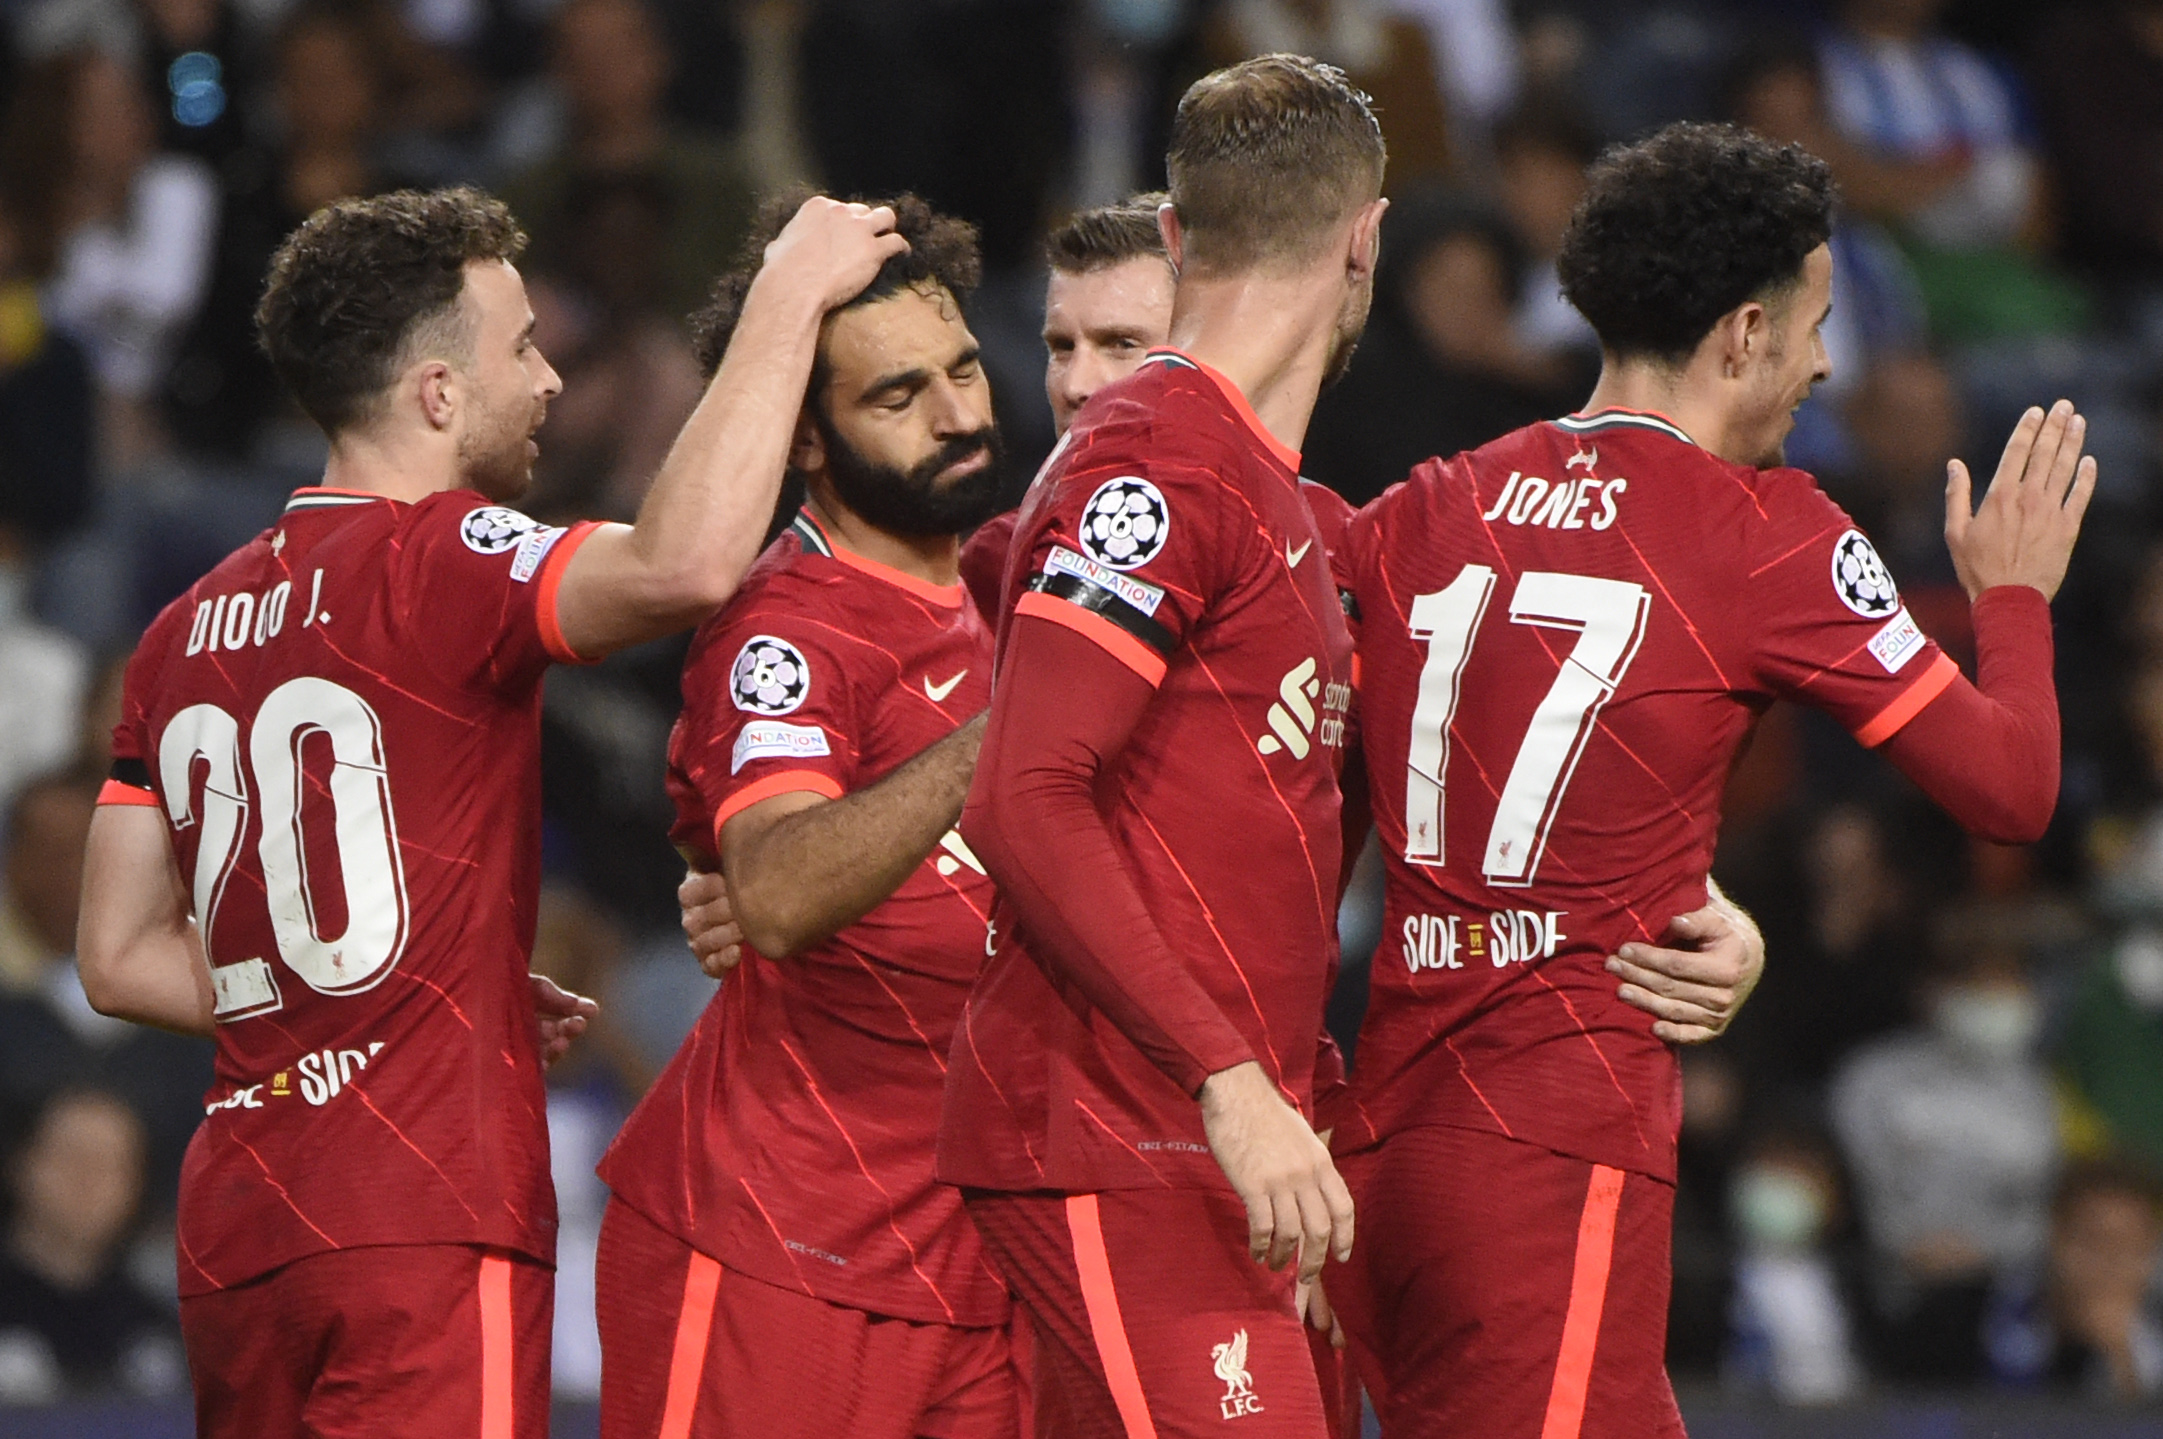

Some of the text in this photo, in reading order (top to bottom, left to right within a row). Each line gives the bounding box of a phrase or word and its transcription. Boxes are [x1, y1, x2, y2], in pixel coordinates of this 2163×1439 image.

[1109, 503, 1134, 540] 6
[1483, 471, 1627, 531] JONES
[302, 568, 332, 629] J.
[1052, 548, 1158, 608] FOUNDATION
[1859, 557, 1882, 587] 6
[753, 659, 776, 688] 6
[1404, 563, 1652, 888] 17
[158, 676, 410, 1024] 20
[1402, 912, 1464, 973] SIDE
[298, 1042, 386, 1106] SID
[1220, 1395, 1265, 1420] L.F.C.
